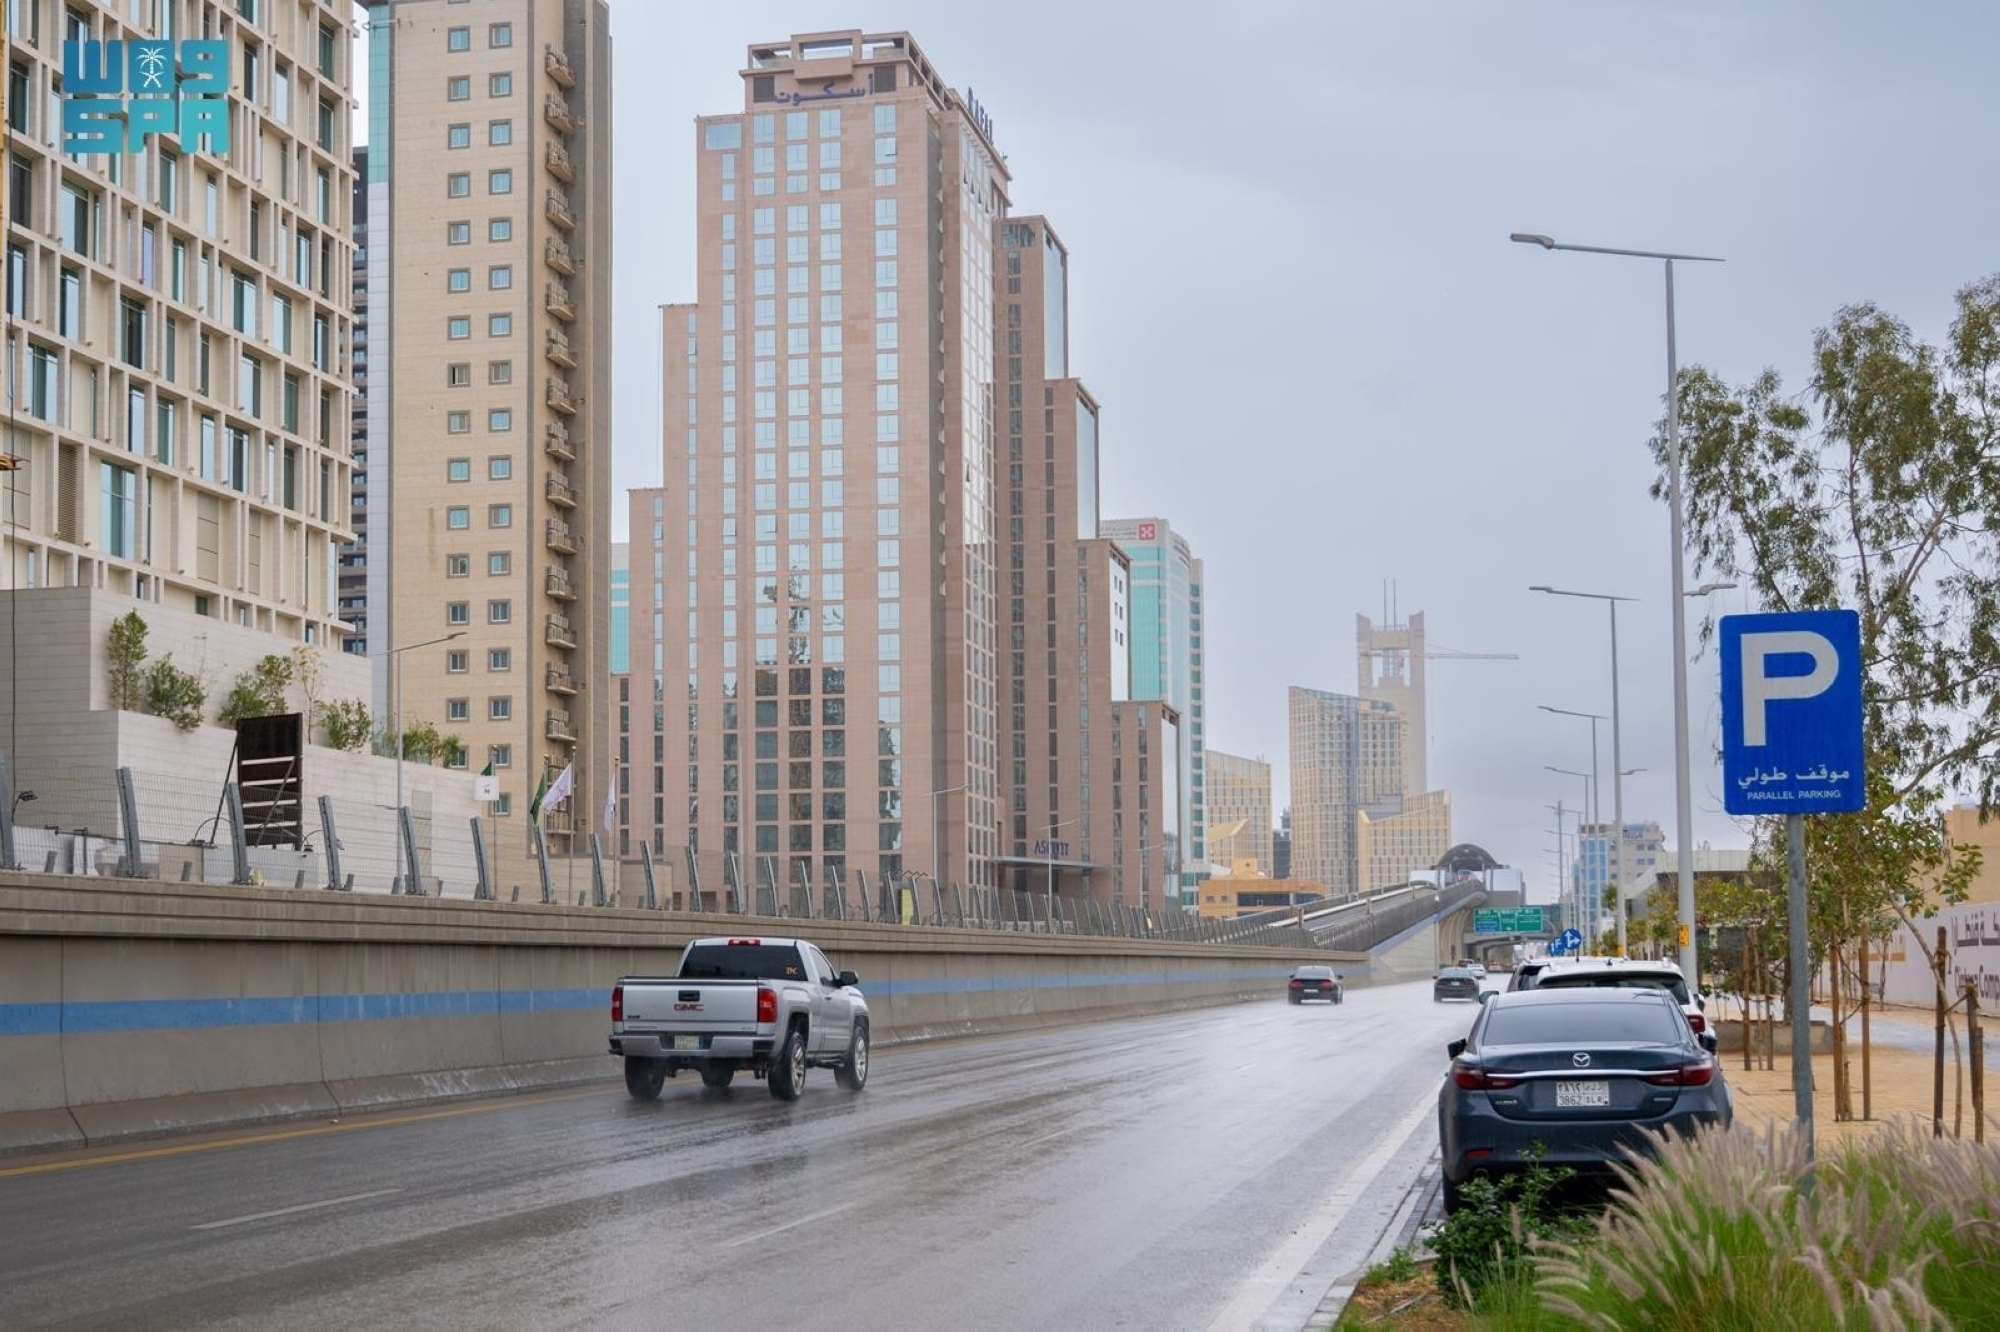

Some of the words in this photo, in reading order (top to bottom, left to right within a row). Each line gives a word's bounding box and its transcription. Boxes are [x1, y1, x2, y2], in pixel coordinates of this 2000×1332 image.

[775, 73, 874, 106] أسكوت
[1740, 630, 1840, 747] P
[1738, 766, 1788, 788] طولي
[1795, 763, 1850, 784] موقف
[1747, 790, 1795, 800] PARALLEL
[1798, 788, 1842, 799] PARKING
[673, 1003, 704, 1012] GMC
[1558, 1095, 1582, 1106] 3862
